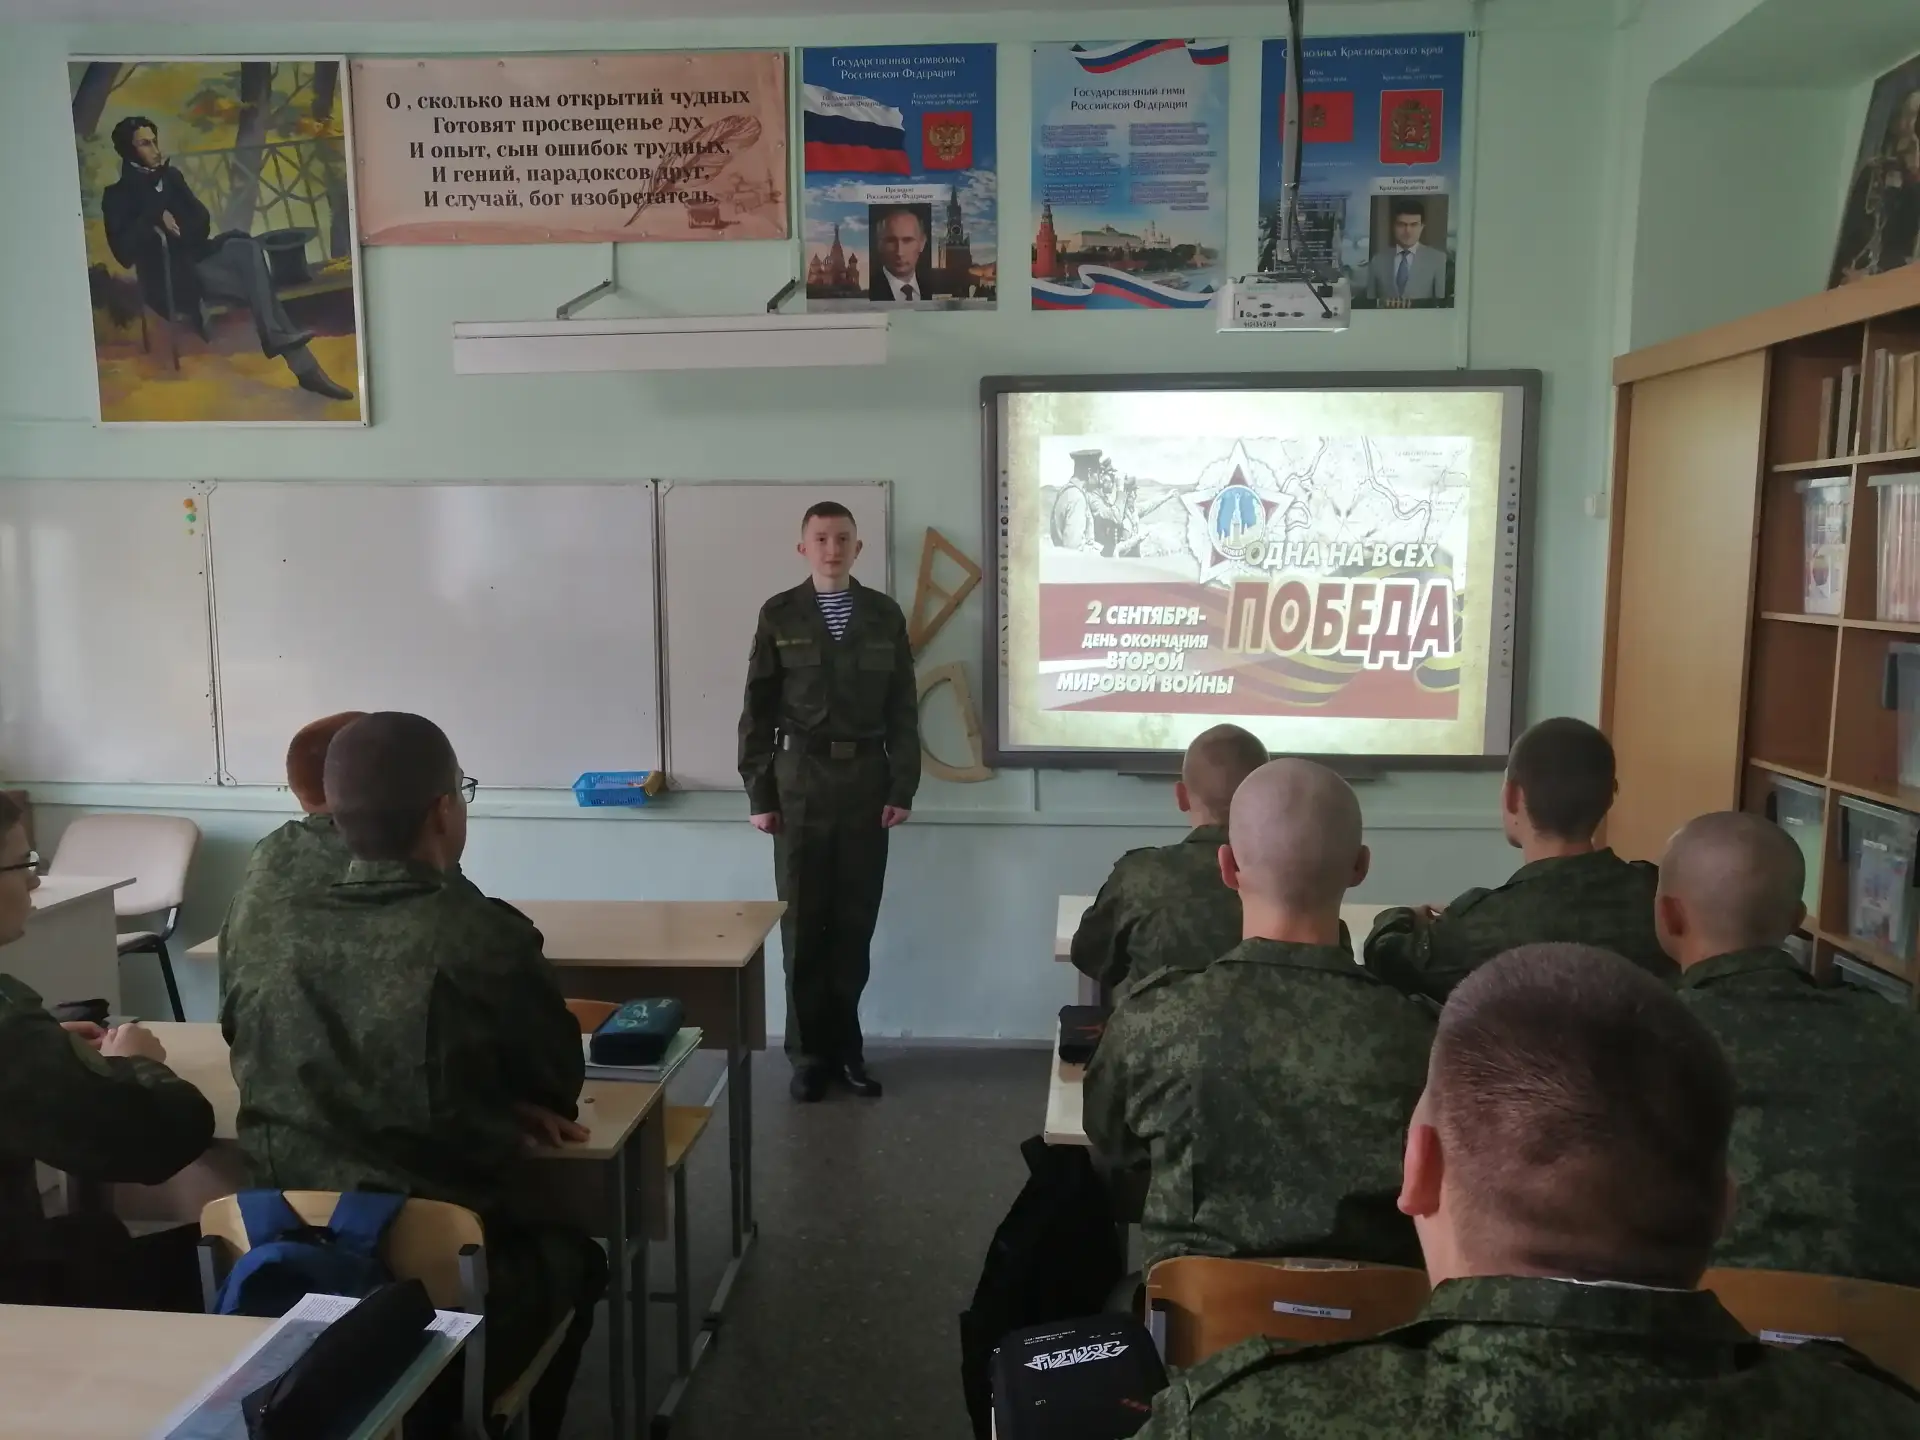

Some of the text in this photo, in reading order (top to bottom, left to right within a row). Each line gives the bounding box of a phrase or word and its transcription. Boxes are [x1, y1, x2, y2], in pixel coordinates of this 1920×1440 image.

[385, 92, 401, 109] О
[417, 95, 503, 109] сколько
[509, 95, 550, 109] нам
[557, 88, 664, 110] открытий
[670, 90, 750, 108] чудных
[1161, 87, 1185, 97] гимн
[1071, 99, 1188, 111] Российской Федерации
[433, 116, 704, 135] Готовят просвещенье дух
[410, 139, 730, 159] И опыт, сын ошибок трудных,
[432, 166, 447, 182] И
[454, 164, 521, 184] гений,
[527, 167, 651, 185] парадоксов
[424, 190, 438, 207] И
[445, 189, 524, 210] случай,
[530, 190, 564, 206] бог
[1244, 541, 1439, 569] ОДНА НА ВСЕХ
[1084, 600, 1208, 626] 2 СЕНТЯБРЯ-
[1222, 575, 1455, 671] ПОБЕДА
[1081, 633, 1209, 649] ДЕНЬ ОКОНЧАНИЯ
[1105, 646, 1186, 672] ВТОРОЙ
[1056, 669, 1235, 694] МИРОВОЙ ВОЙНЫ
